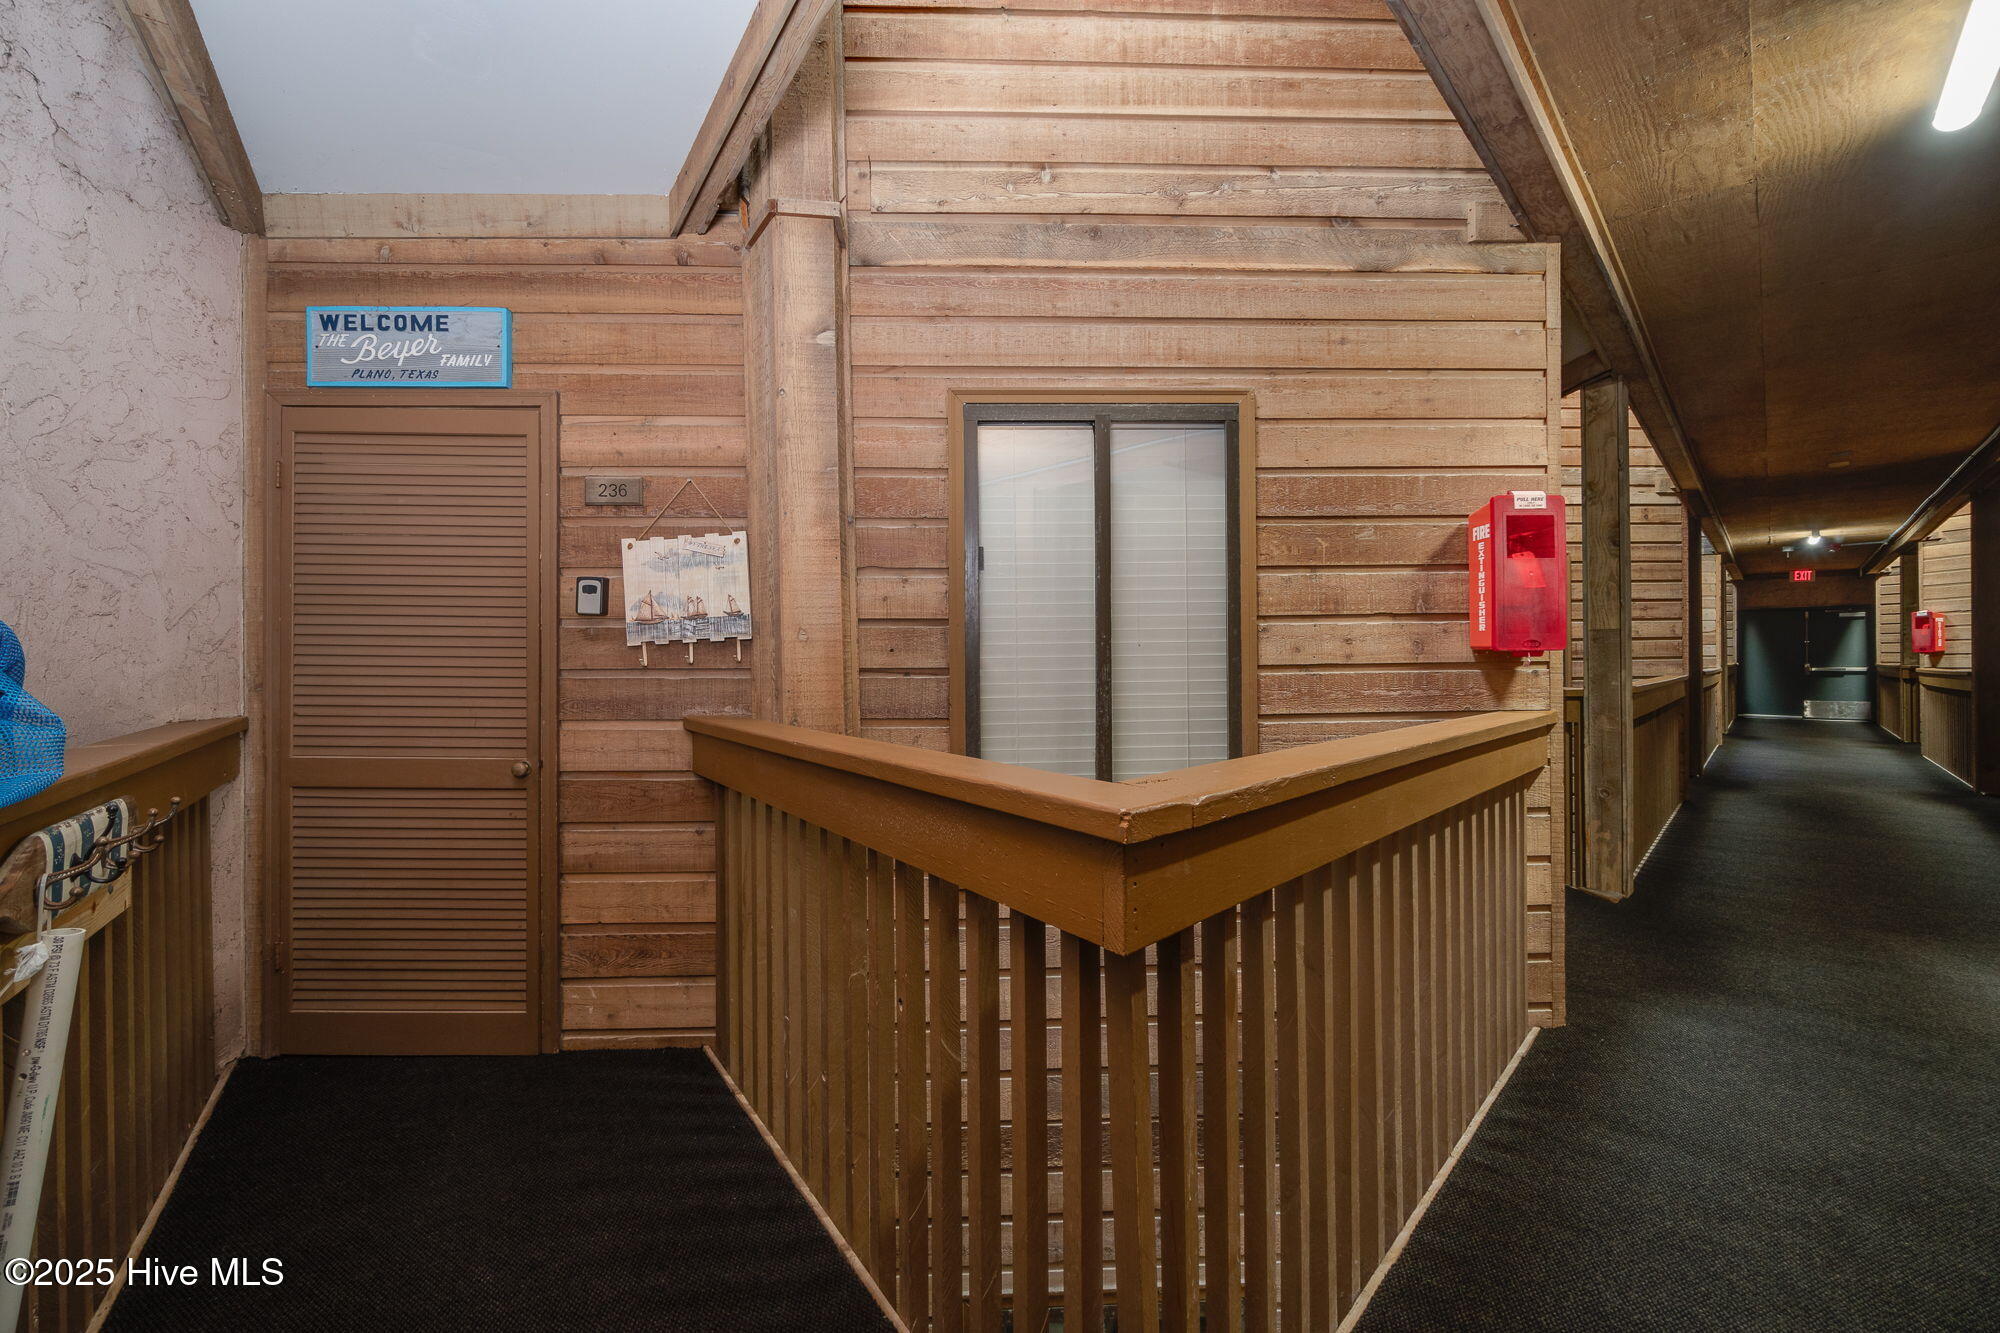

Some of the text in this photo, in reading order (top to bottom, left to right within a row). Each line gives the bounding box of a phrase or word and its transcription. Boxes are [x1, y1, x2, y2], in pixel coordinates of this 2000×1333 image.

[318, 313, 450, 332] WELCOME
[318, 333, 493, 367] THE Beyer FAMILY
[351, 368, 440, 381] PLANO, TEXAS
[598, 483, 628, 498] 236
[1472, 524, 1490, 541] FIRE
[1794, 570, 1812, 581] EXIT
[1478, 542, 1486, 631] EXTINGUISHER
[51, 944, 63, 953] PSI
[45, 974, 58, 988] ASTM
[40, 1005, 51, 1020] ASTM
